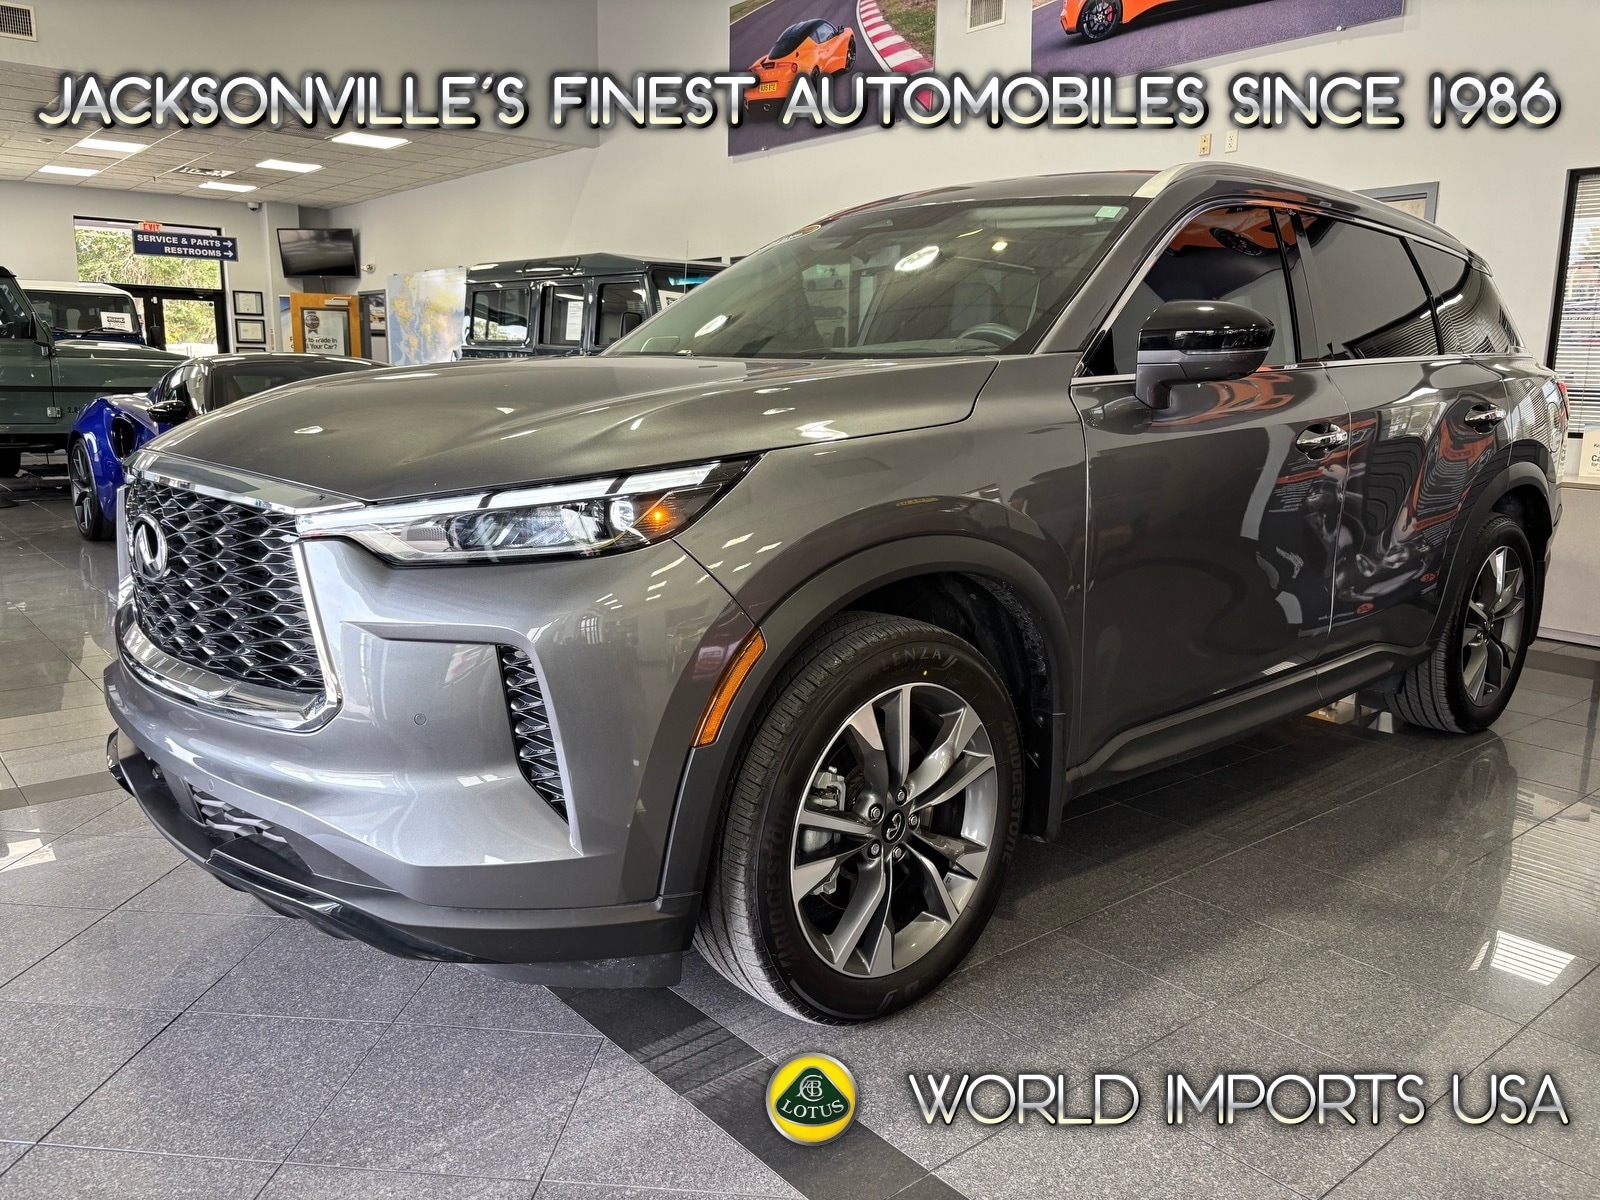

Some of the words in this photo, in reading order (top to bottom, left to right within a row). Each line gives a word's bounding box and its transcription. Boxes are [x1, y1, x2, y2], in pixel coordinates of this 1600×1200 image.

[137, 234, 178, 244] SERVICE
[190, 238, 221, 247] PARTS
[164, 246, 222, 257] RESTROOMS
